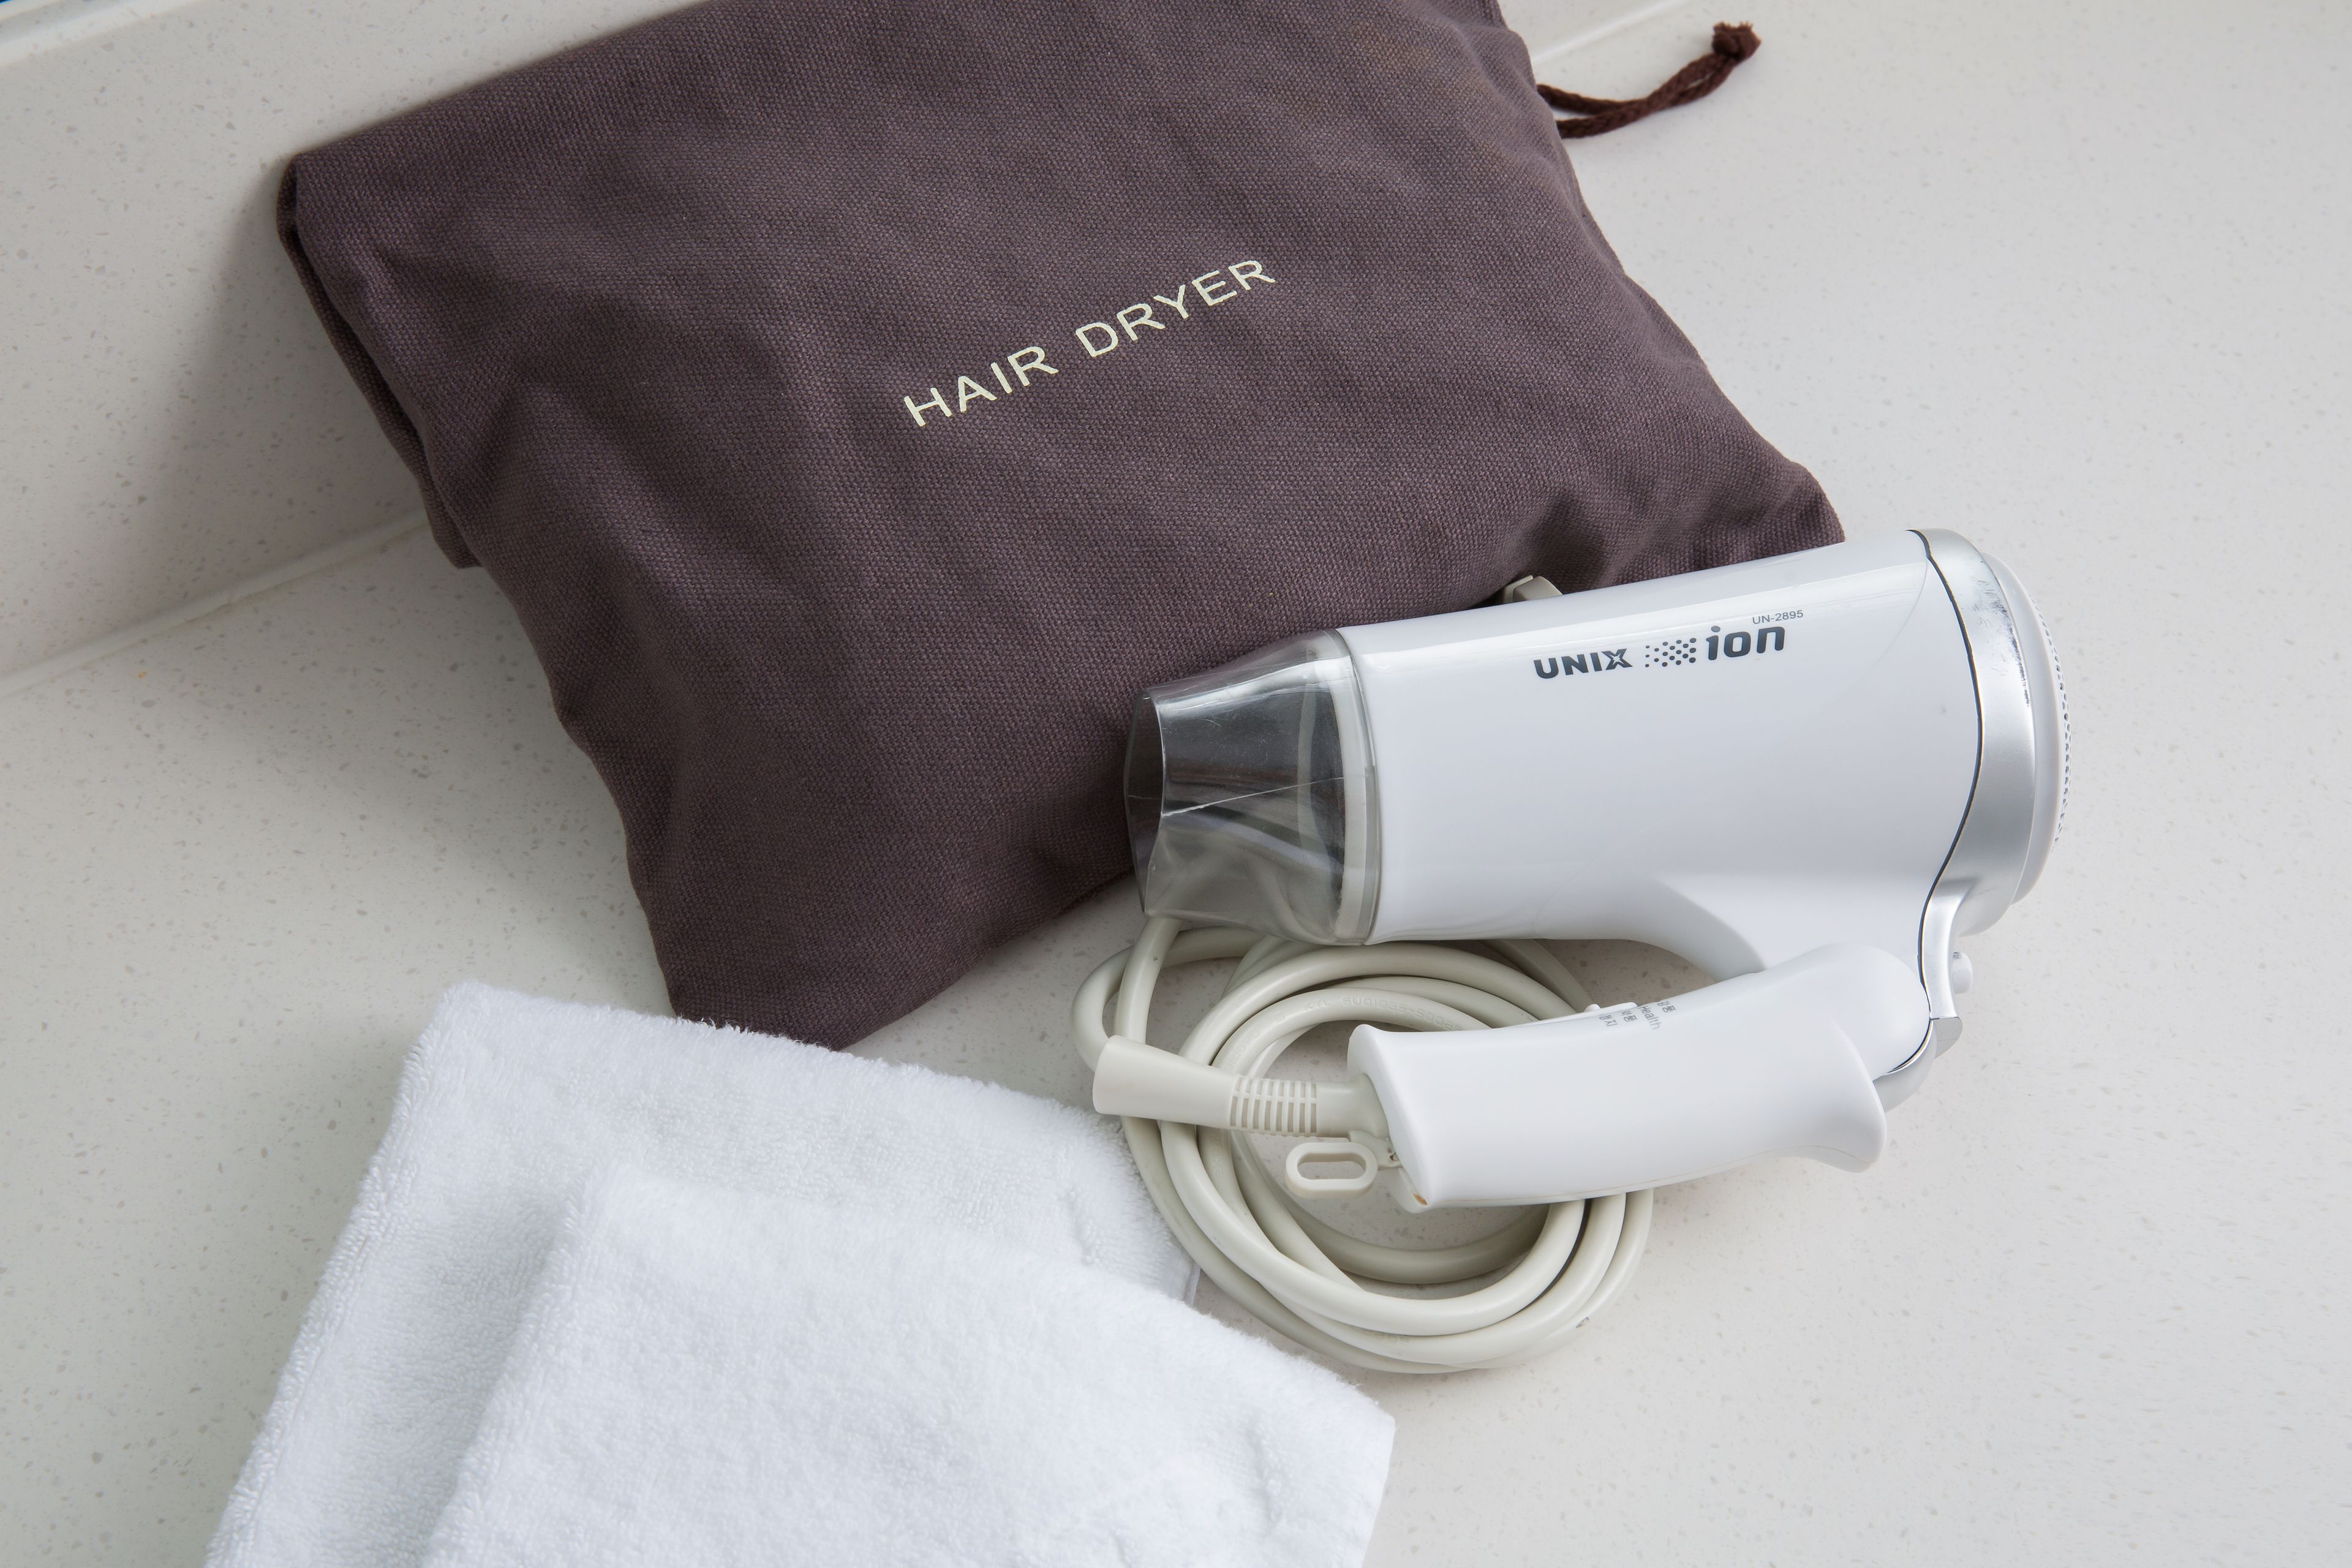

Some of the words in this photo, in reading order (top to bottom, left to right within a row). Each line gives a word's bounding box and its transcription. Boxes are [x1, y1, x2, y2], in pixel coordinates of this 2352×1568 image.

[903, 345, 1059, 427] HAIR
[1075, 260, 1276, 358] DRYER
[1752, 609, 1803, 625] UN-2895
[1533, 648, 1633, 679] UNIX
[1705, 625, 1785, 661] ion
[1637, 1005, 1662, 1030] Health
[1656, 1000, 1676, 1014] 강풍
